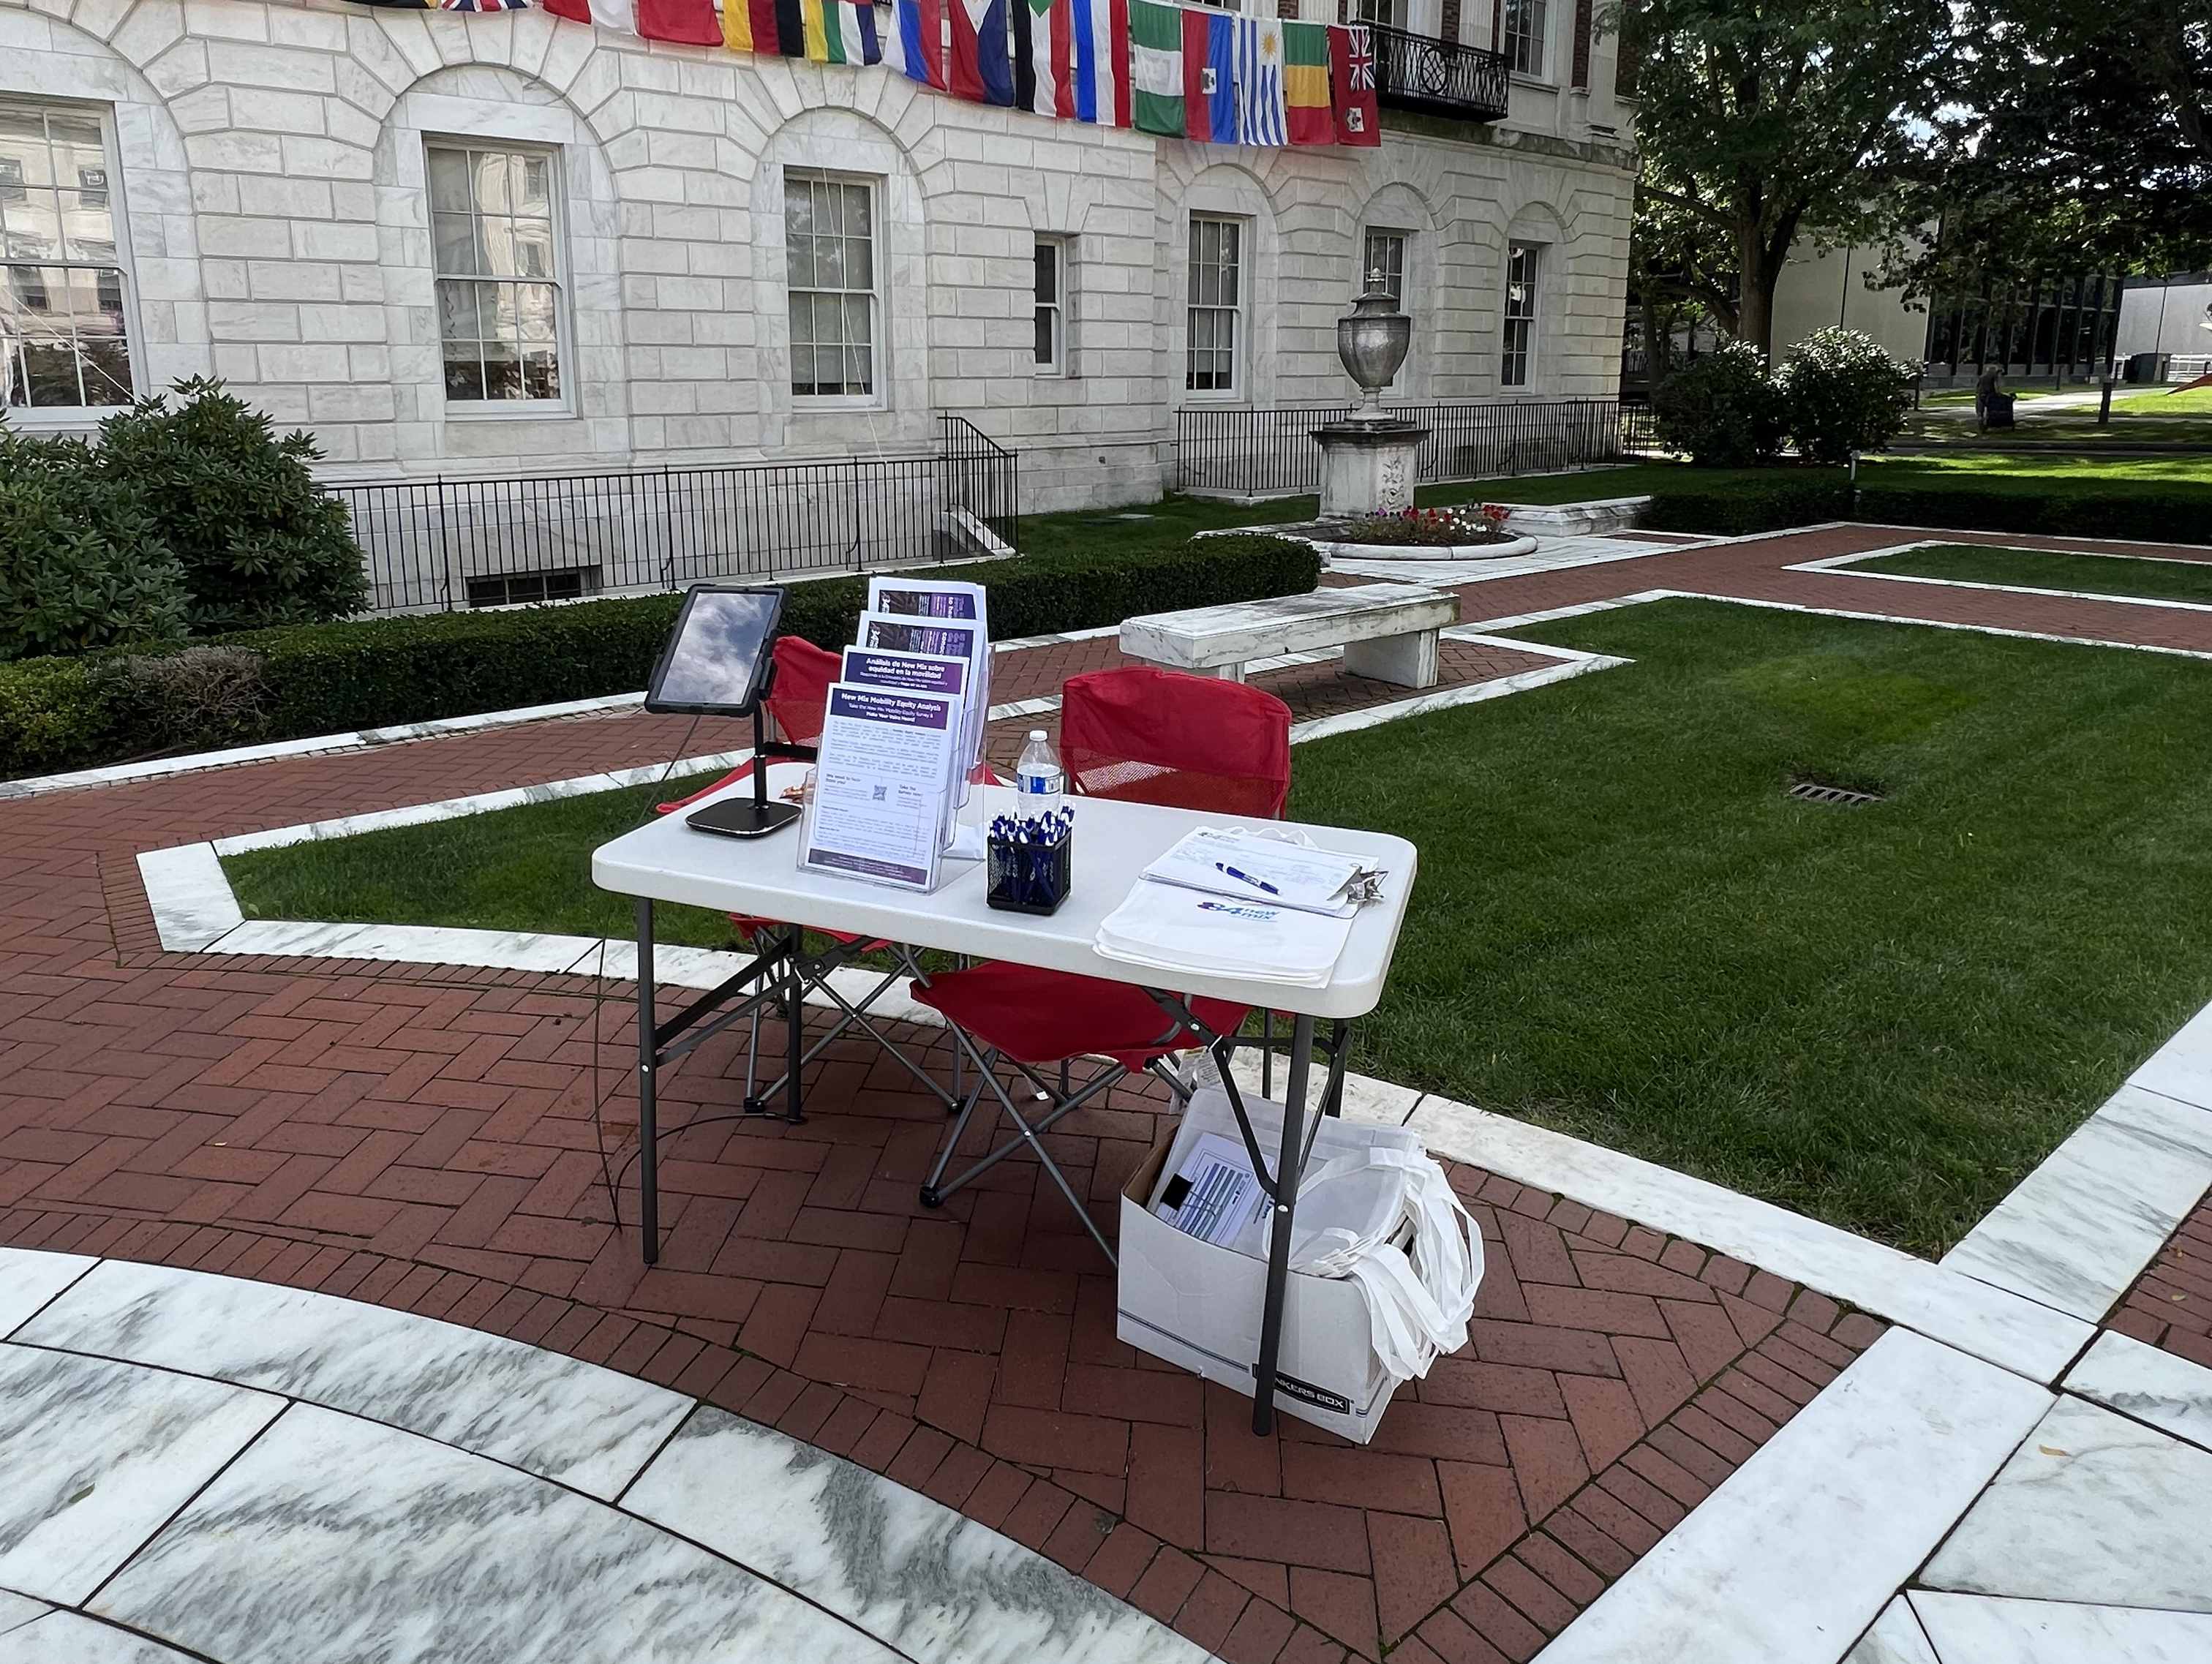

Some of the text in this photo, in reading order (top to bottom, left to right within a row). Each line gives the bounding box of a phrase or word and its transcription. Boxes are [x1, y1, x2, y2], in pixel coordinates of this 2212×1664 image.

[866, 658, 891, 667] Análisis
[928, 664, 945, 672] sobre
[868, 666, 895, 676] equidad
[911, 670, 942, 679] movilidad
[841, 693, 941, 712] New Mix Mobility Equity Analysis
[1243, 908, 1281, 916] new
[1275, 1377, 1345, 1409] NKERS BOX
